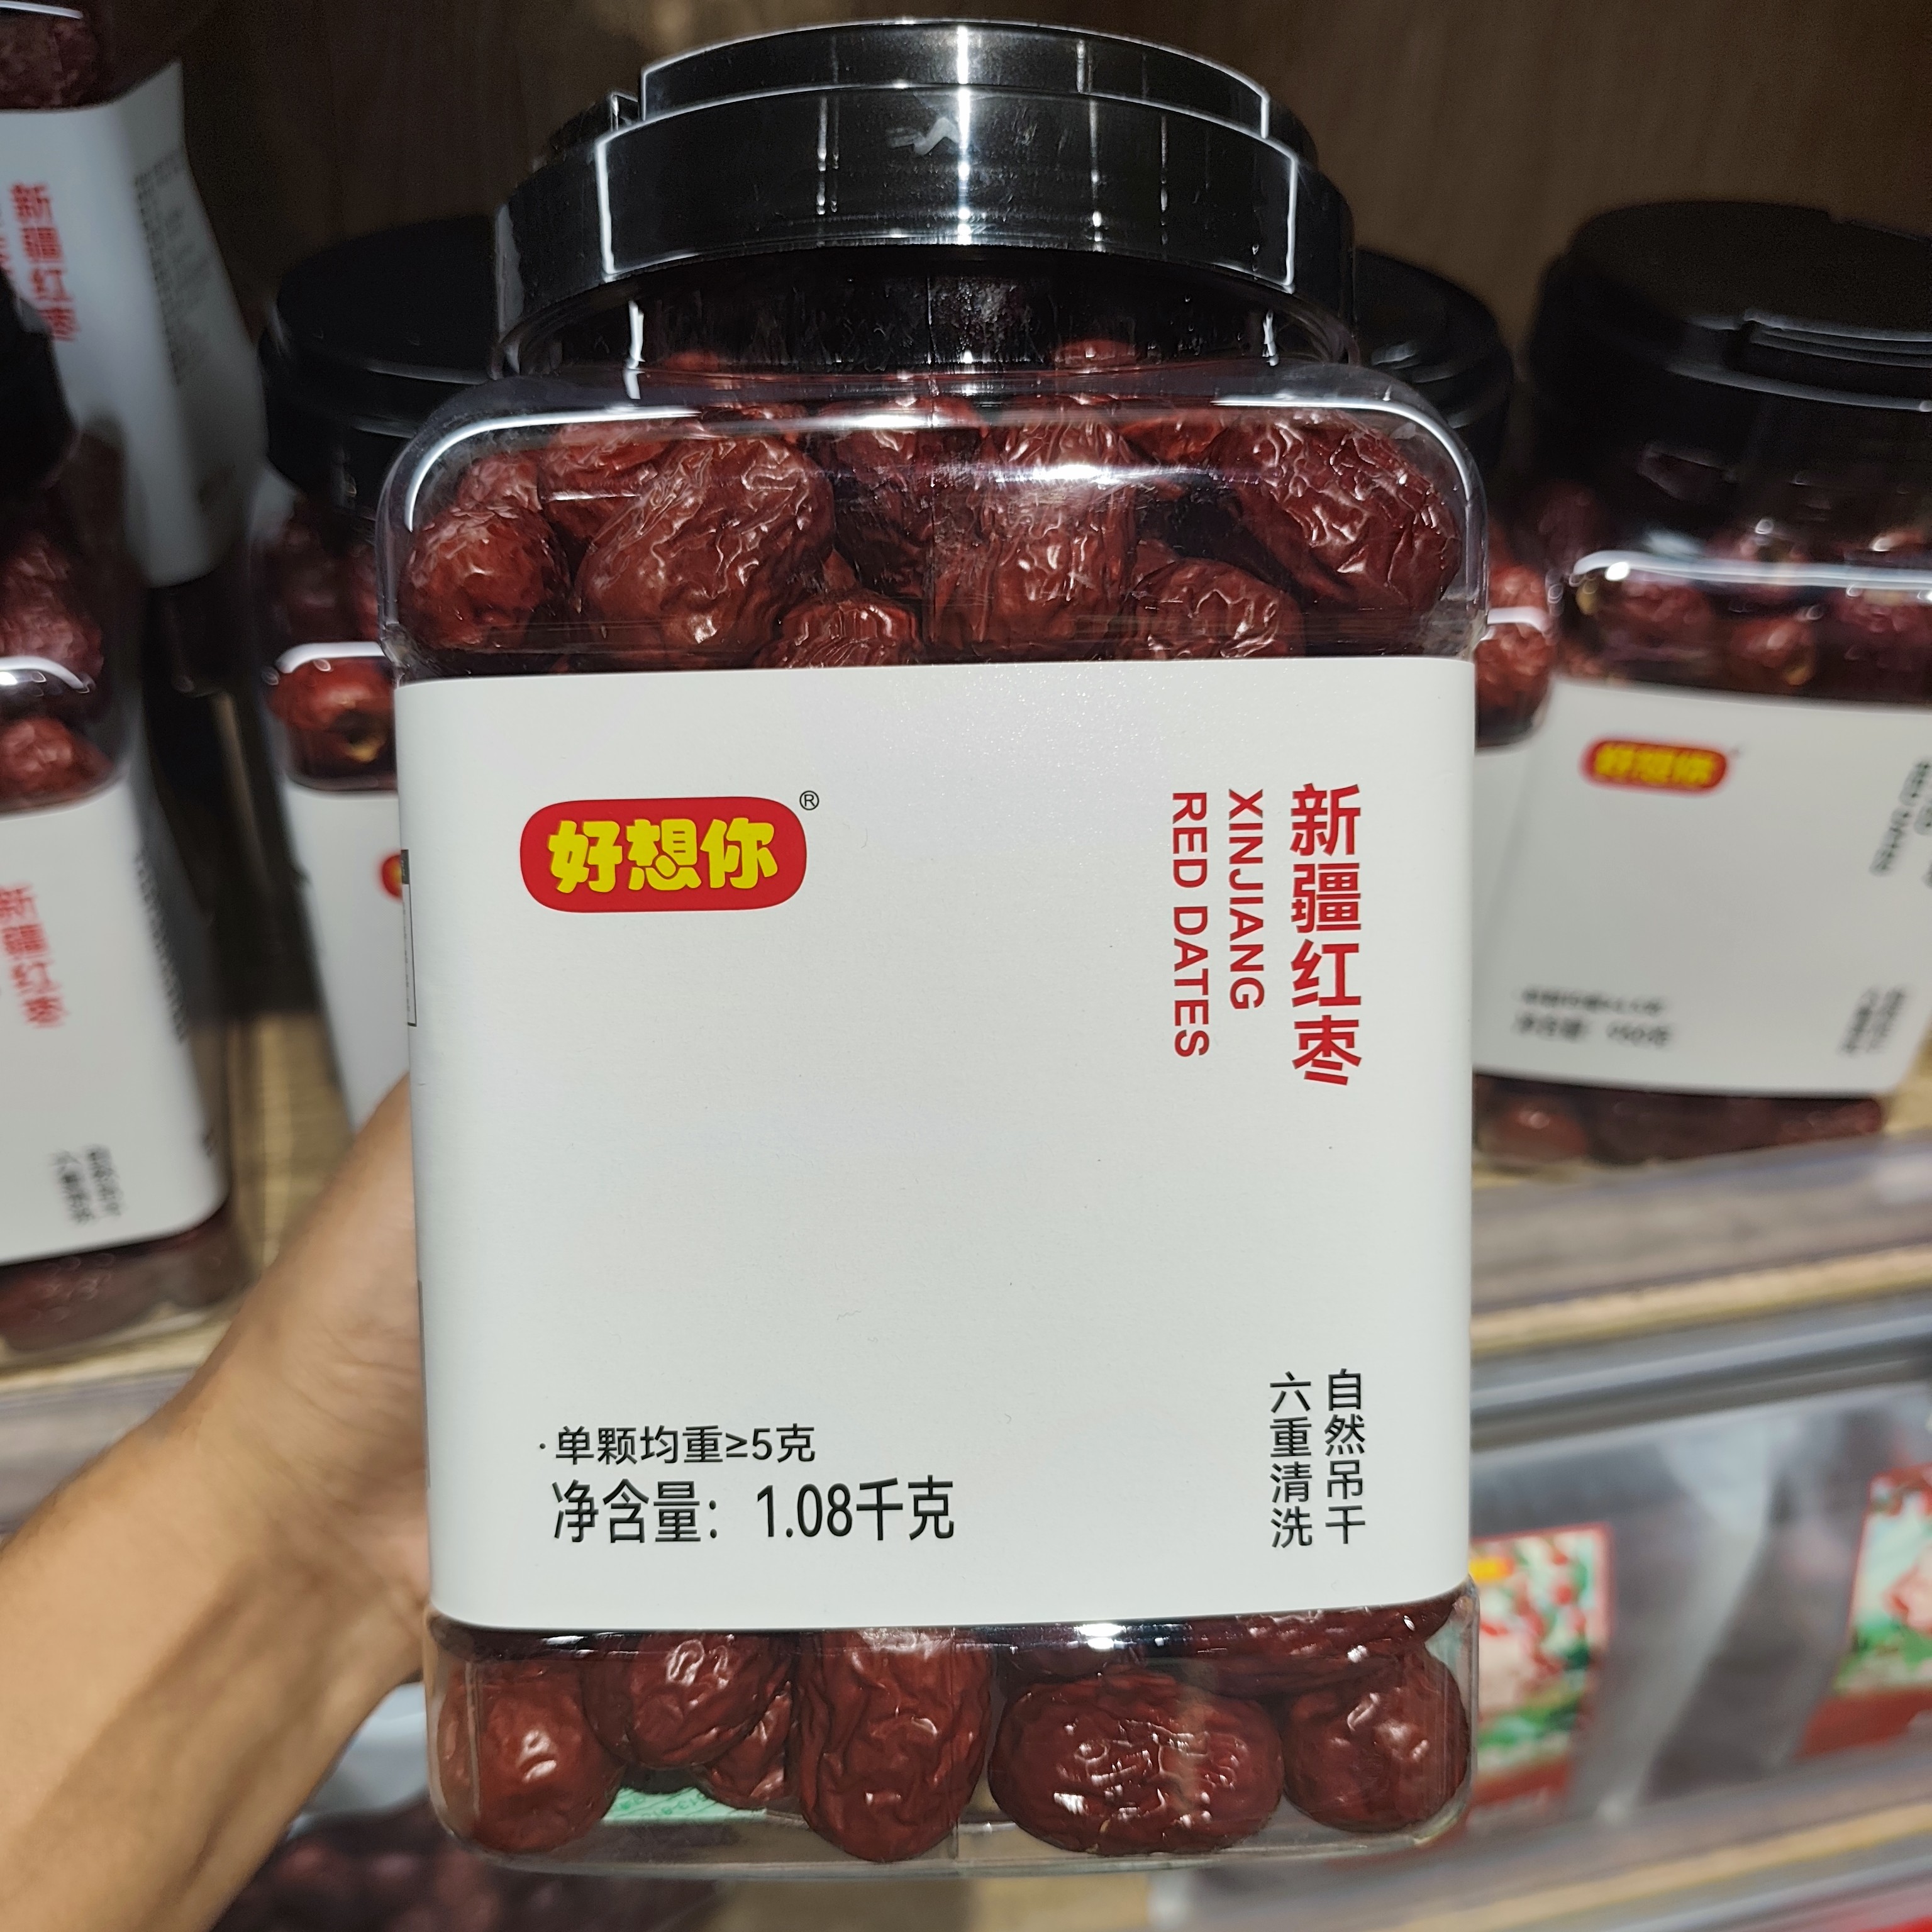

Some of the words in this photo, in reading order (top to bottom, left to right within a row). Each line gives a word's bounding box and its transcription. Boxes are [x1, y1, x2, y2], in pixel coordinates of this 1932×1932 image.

[547, 817, 779, 894] 好想你
[1172, 792, 1208, 889] RED
[1228, 788, 1265, 1010] XINJIANG
[1173, 906, 1210, 1058] DATES
[1290, 783, 1362, 1086] 新疆红枣
[1269, 1370, 1313, 1548] 六重清洗
[1324, 1367, 1366, 1545] 自然吊干
